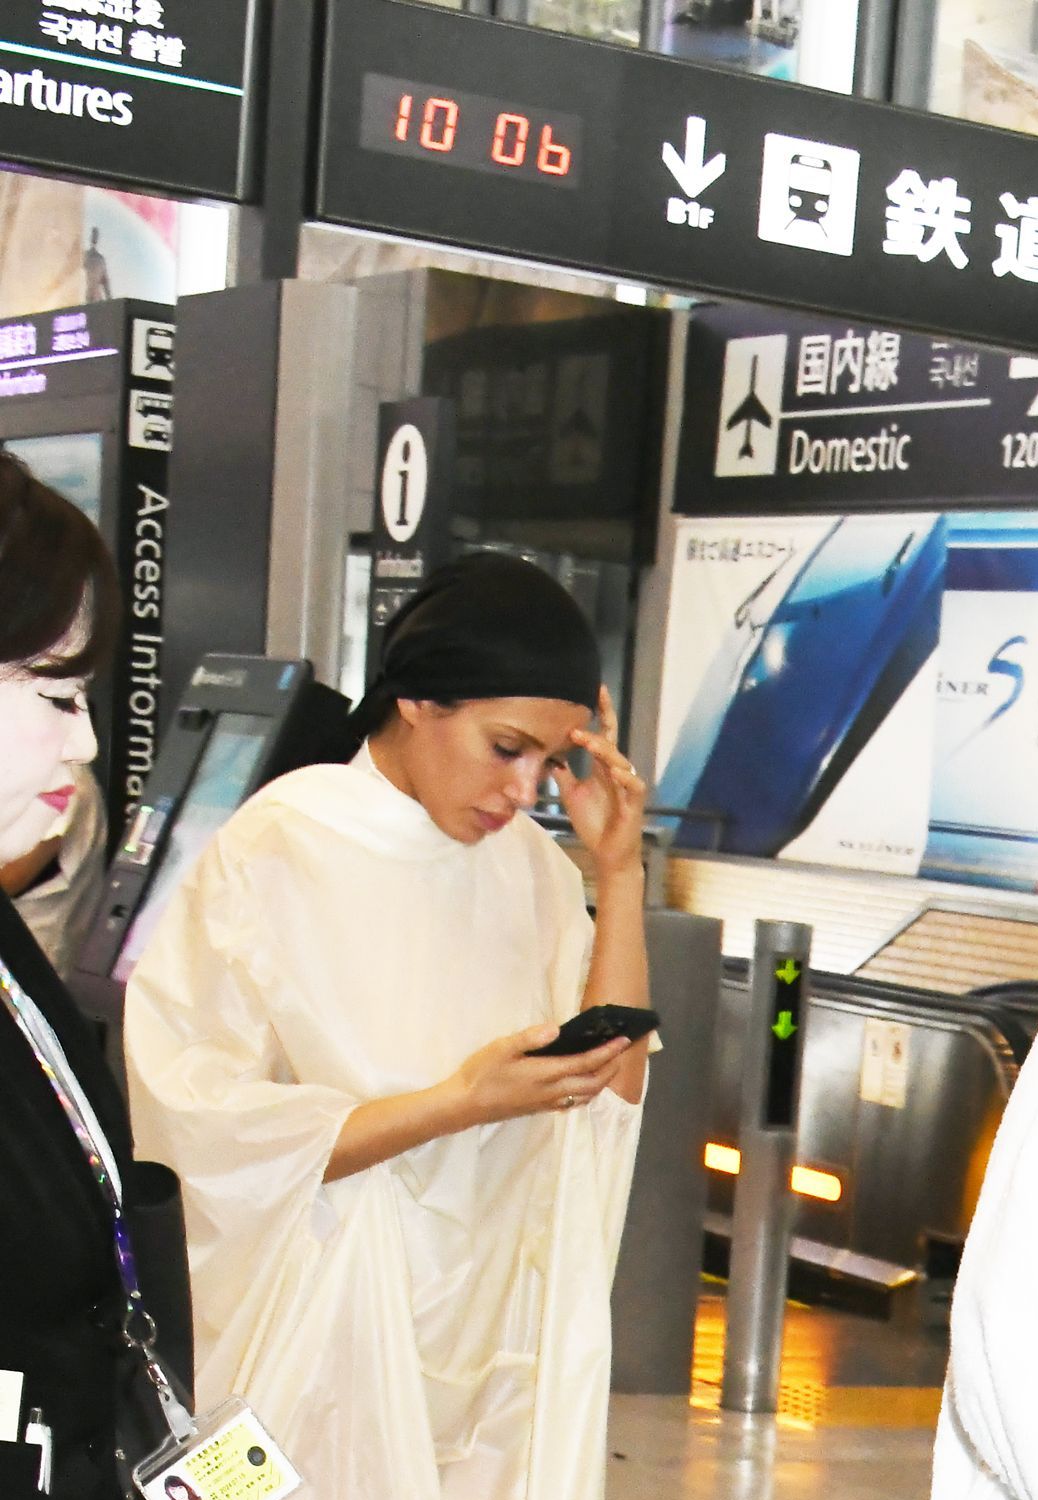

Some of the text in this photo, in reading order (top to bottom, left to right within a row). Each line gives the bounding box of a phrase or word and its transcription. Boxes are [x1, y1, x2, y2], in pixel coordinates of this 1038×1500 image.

[39, 11, 186, 67] 국제선 출발
[667, 197, 714, 229] B1F
[797, 330, 901, 396] 国内線
[789, 423, 912, 474] Domestic
[125, 483, 171, 824] Access Informa
